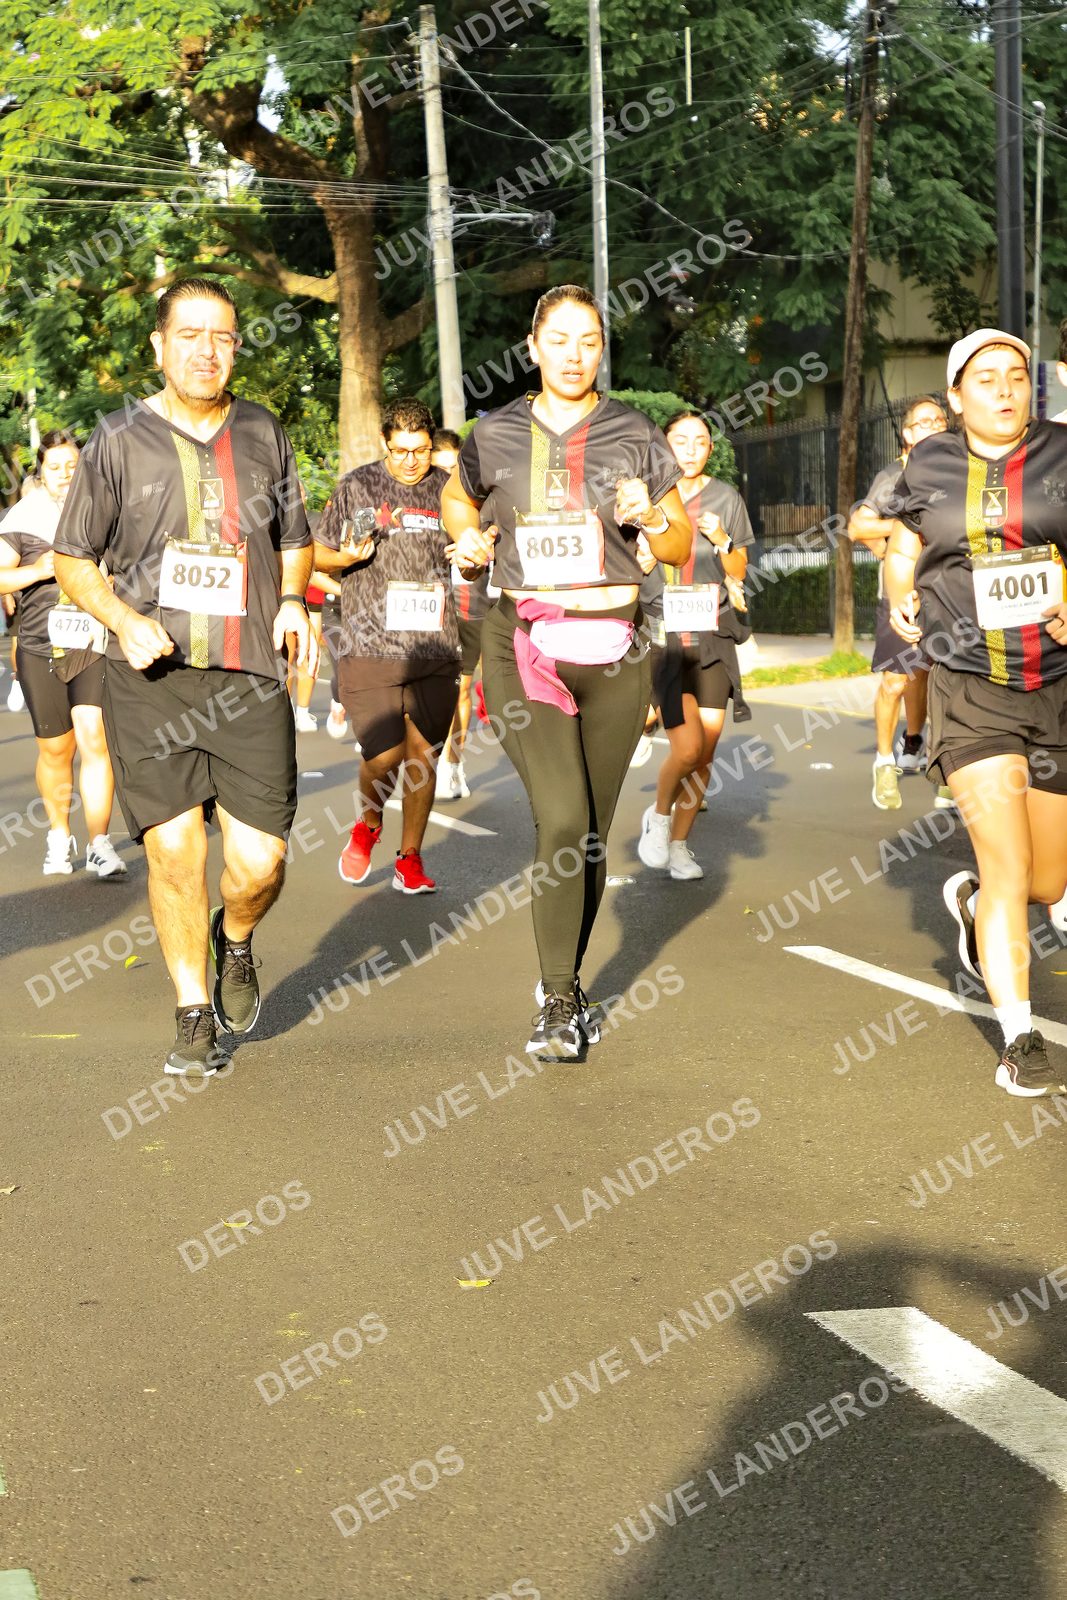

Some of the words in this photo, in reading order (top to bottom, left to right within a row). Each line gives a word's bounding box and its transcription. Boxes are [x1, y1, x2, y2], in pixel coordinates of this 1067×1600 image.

[526, 535, 584, 559] 8053
[172, 563, 231, 589] 8052
[988, 571, 1049, 601] 4001
[393, 598, 437, 613] 12140
[55, 618, 90, 632] 4778
